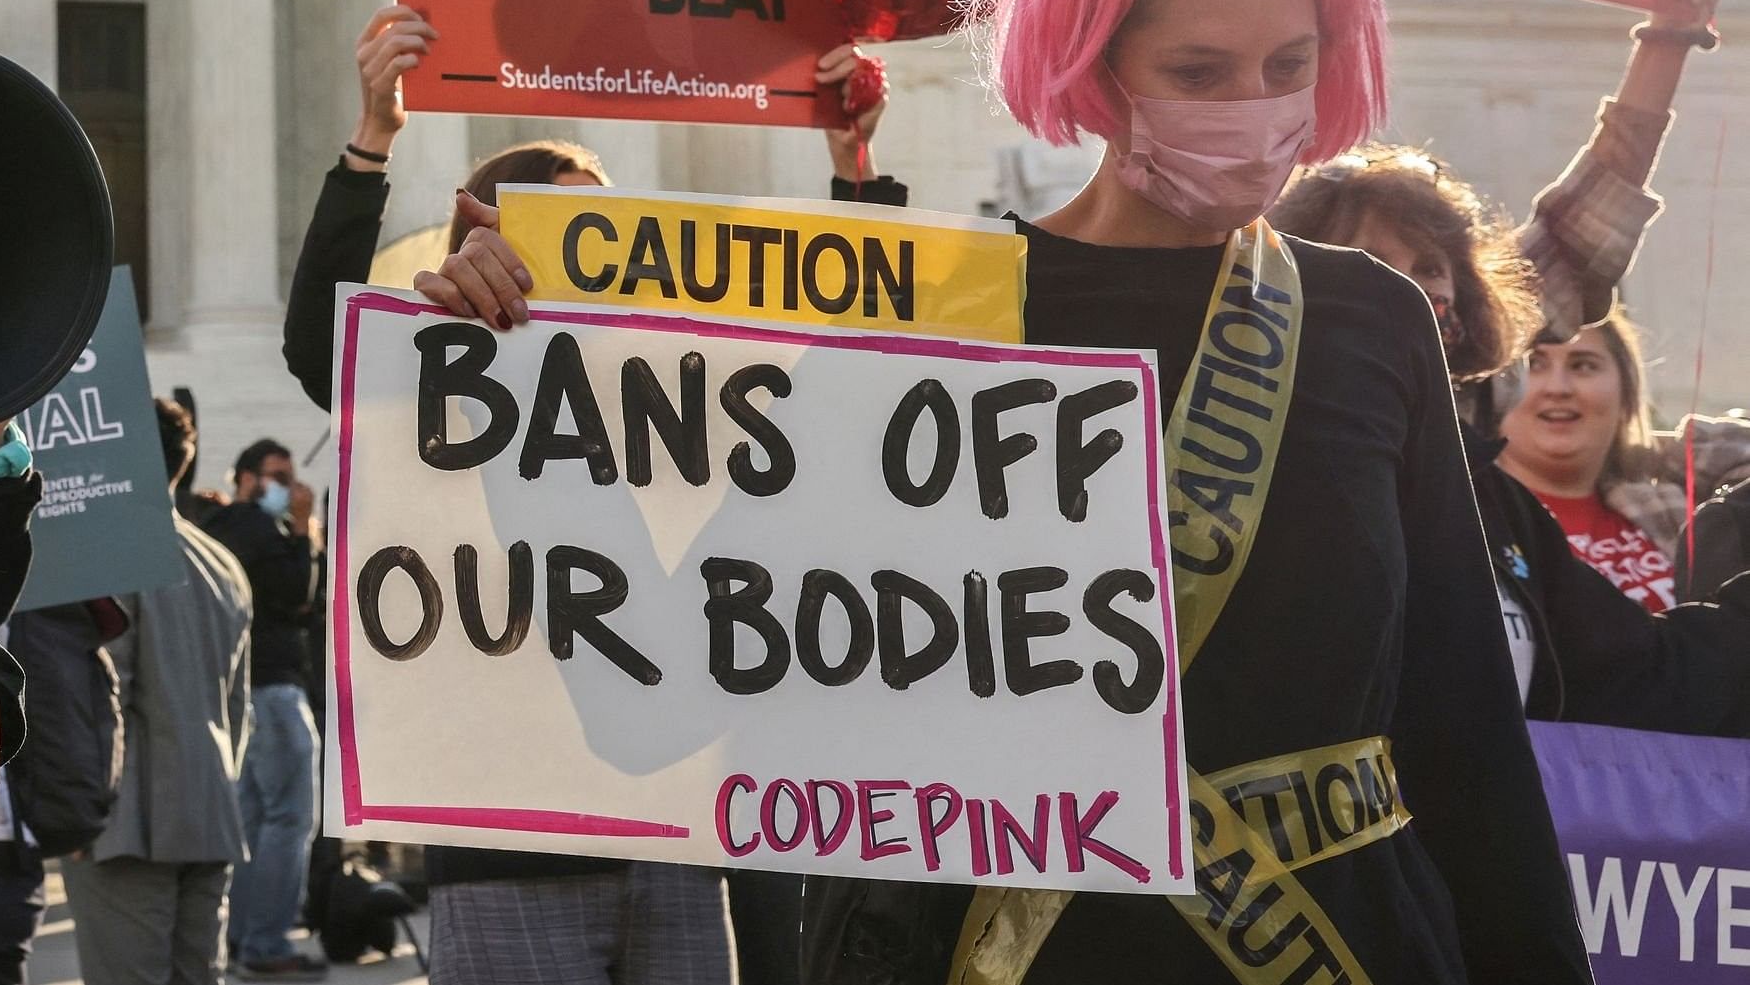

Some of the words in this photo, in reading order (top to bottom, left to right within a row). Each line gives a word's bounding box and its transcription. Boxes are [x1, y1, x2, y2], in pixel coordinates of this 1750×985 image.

[500, 62, 769, 109] StudentsforLifeAction.org
[561, 212, 916, 322] CAUTION
[413, 322, 797, 498] BANS
[881, 377, 1141, 524] OFF
[1169, 262, 1292, 576] CAUTION
[37, 501, 87, 519] RIGHTS
[356, 539, 663, 687] OUR
[700, 555, 1166, 716] BODIES
[715, 773, 1151, 885] CODEPINK
